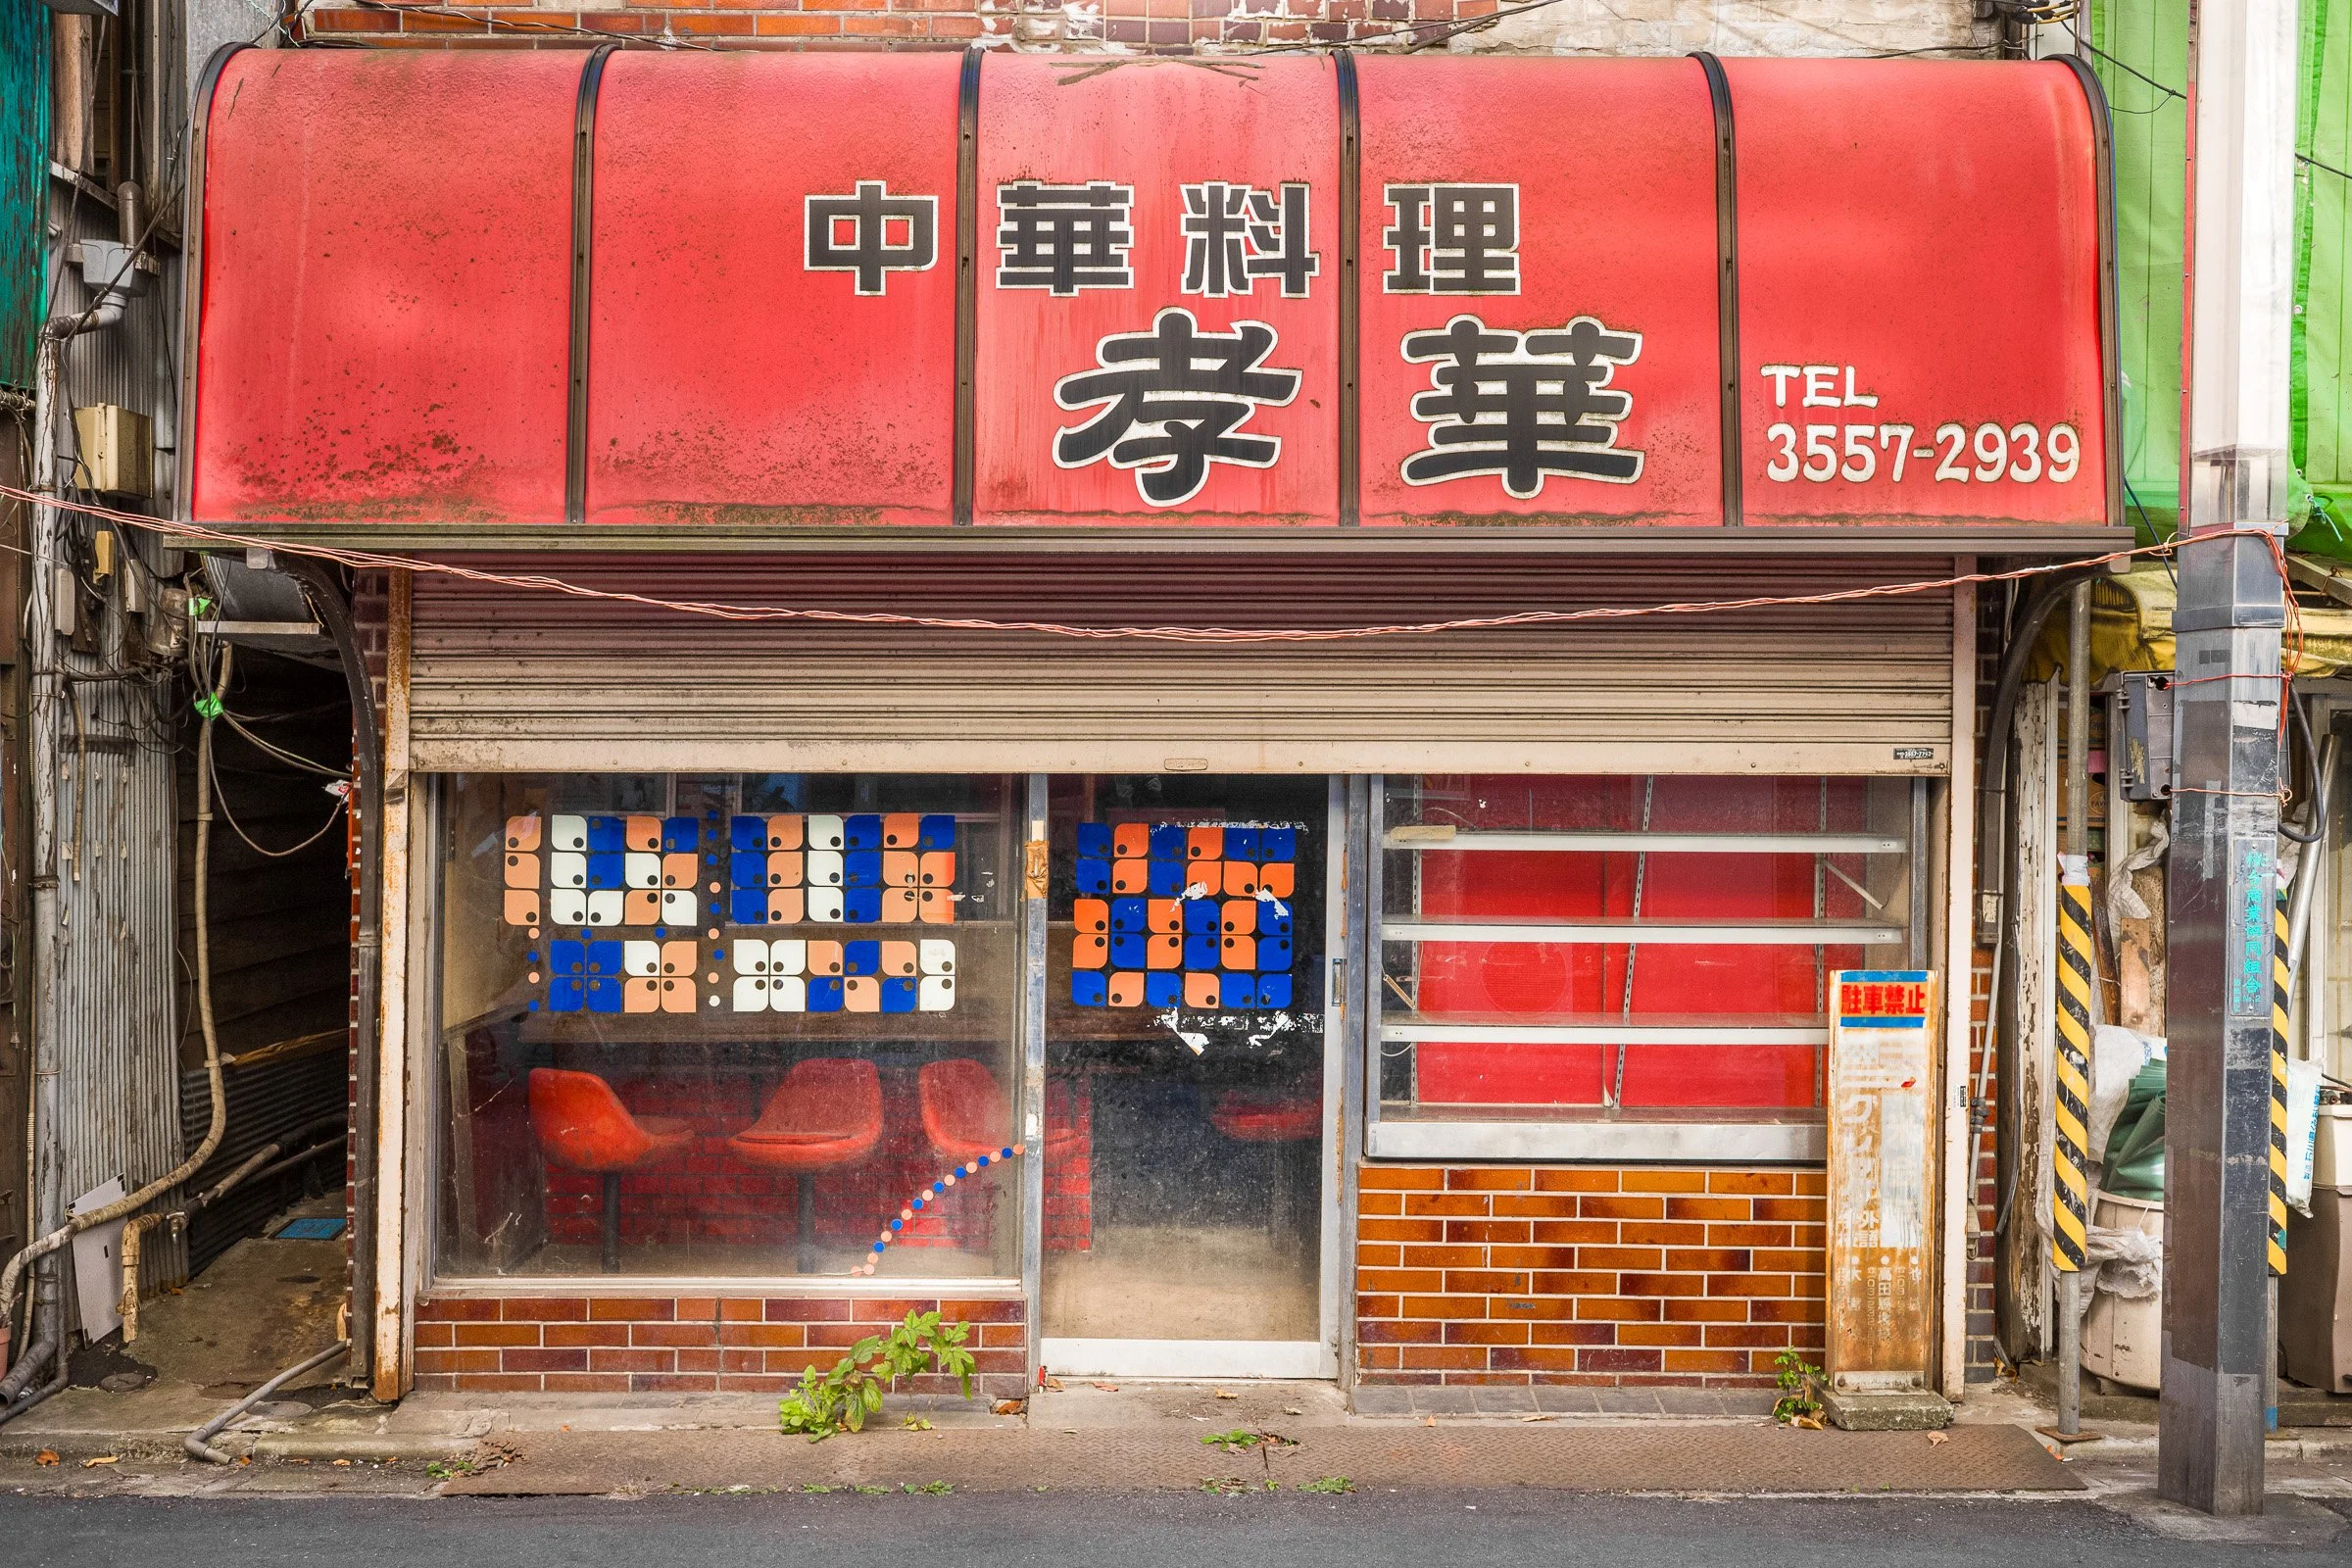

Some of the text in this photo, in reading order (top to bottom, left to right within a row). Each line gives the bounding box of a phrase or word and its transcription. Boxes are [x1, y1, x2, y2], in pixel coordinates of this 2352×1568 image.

[803, 180, 1522, 298] 中華料理
[1052, 307, 1646, 509] 孝華
[1760, 364, 1880, 409] TEL
[1766, 421, 2081, 484] 3557-2939
[1840, 984, 1926, 1015] 駐車禁止
